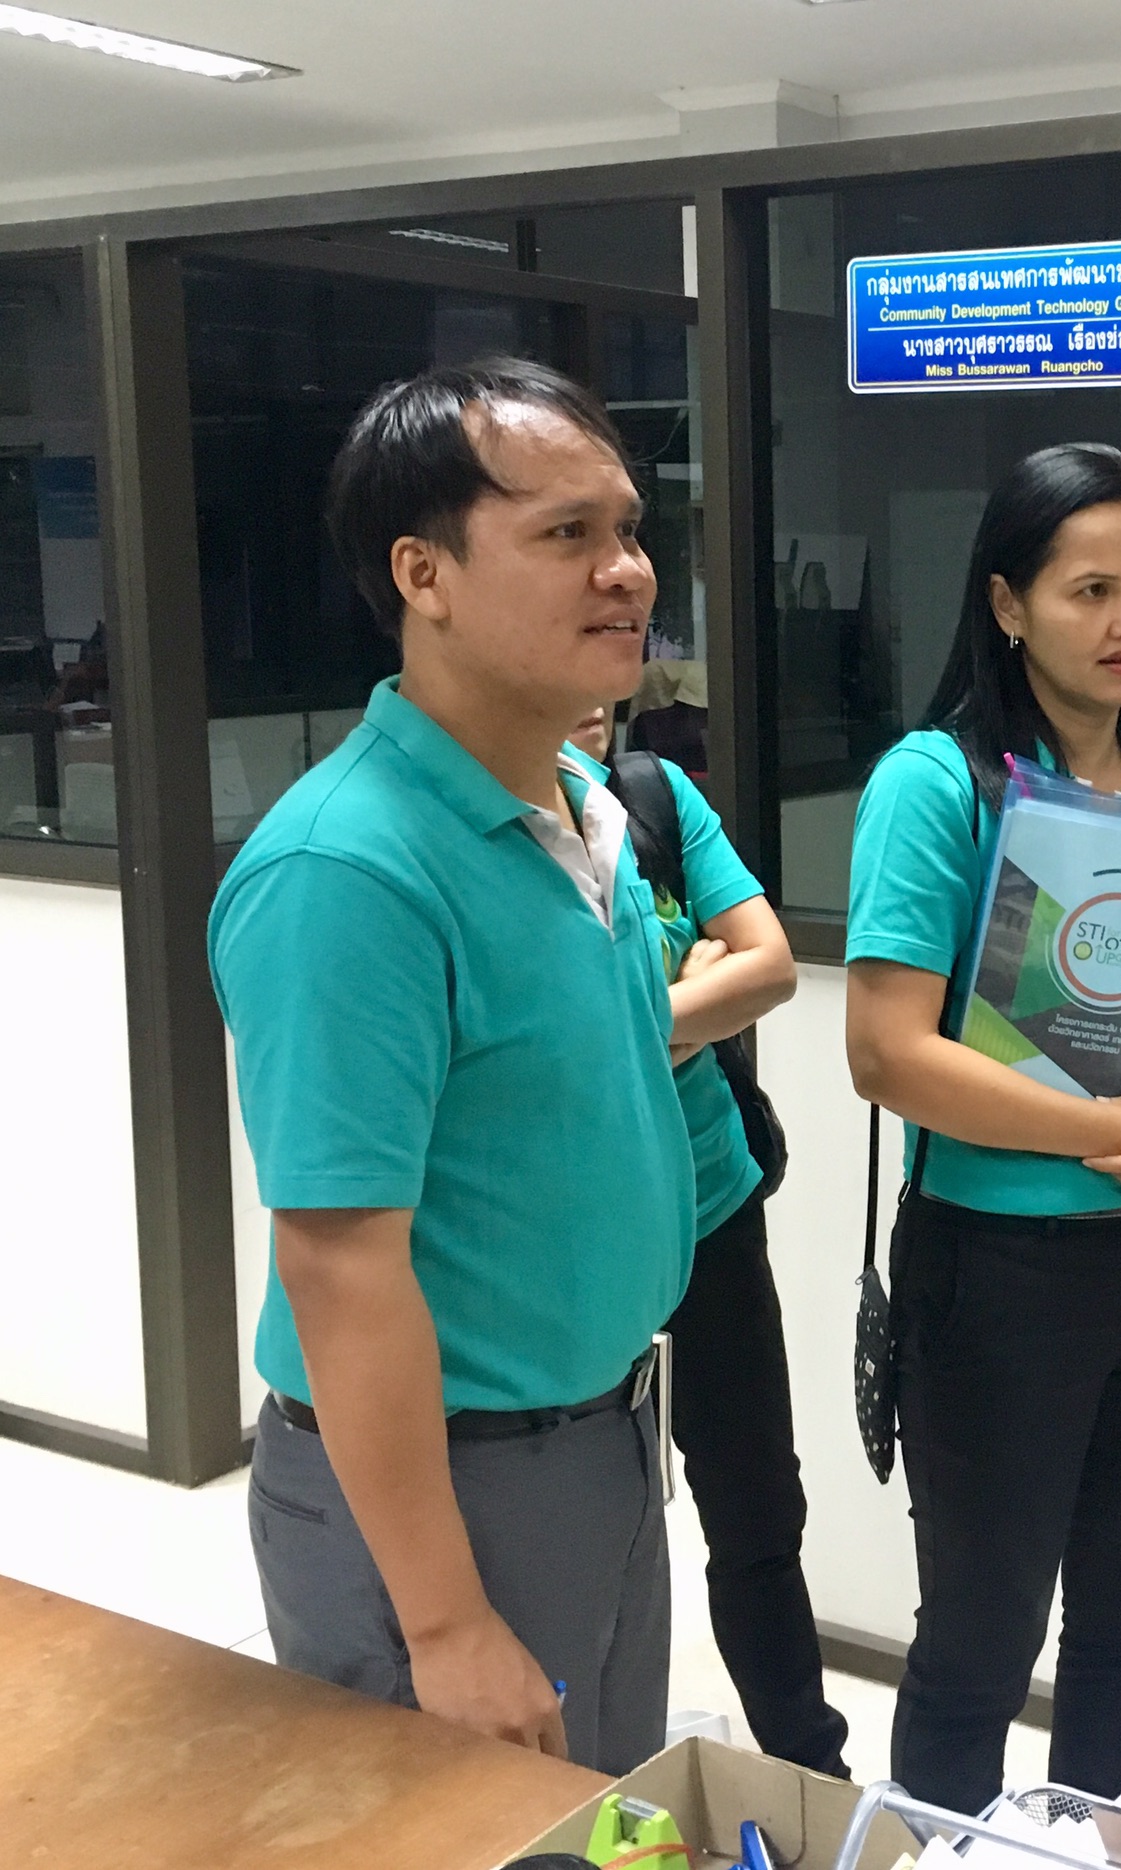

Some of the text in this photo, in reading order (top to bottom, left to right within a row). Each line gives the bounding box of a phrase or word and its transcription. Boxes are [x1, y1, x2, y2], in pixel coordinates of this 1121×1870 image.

[880, 305, 947, 323] Community
[951, 301, 1032, 320] Development
[1036, 298, 1110, 316] Technology
[903, 333, 1053, 364] นางสาวบุศราวรรณ
[925, 359, 1104, 377] Miss Bussarawan Ruangcho
[1076, 921, 1106, 941] STI
